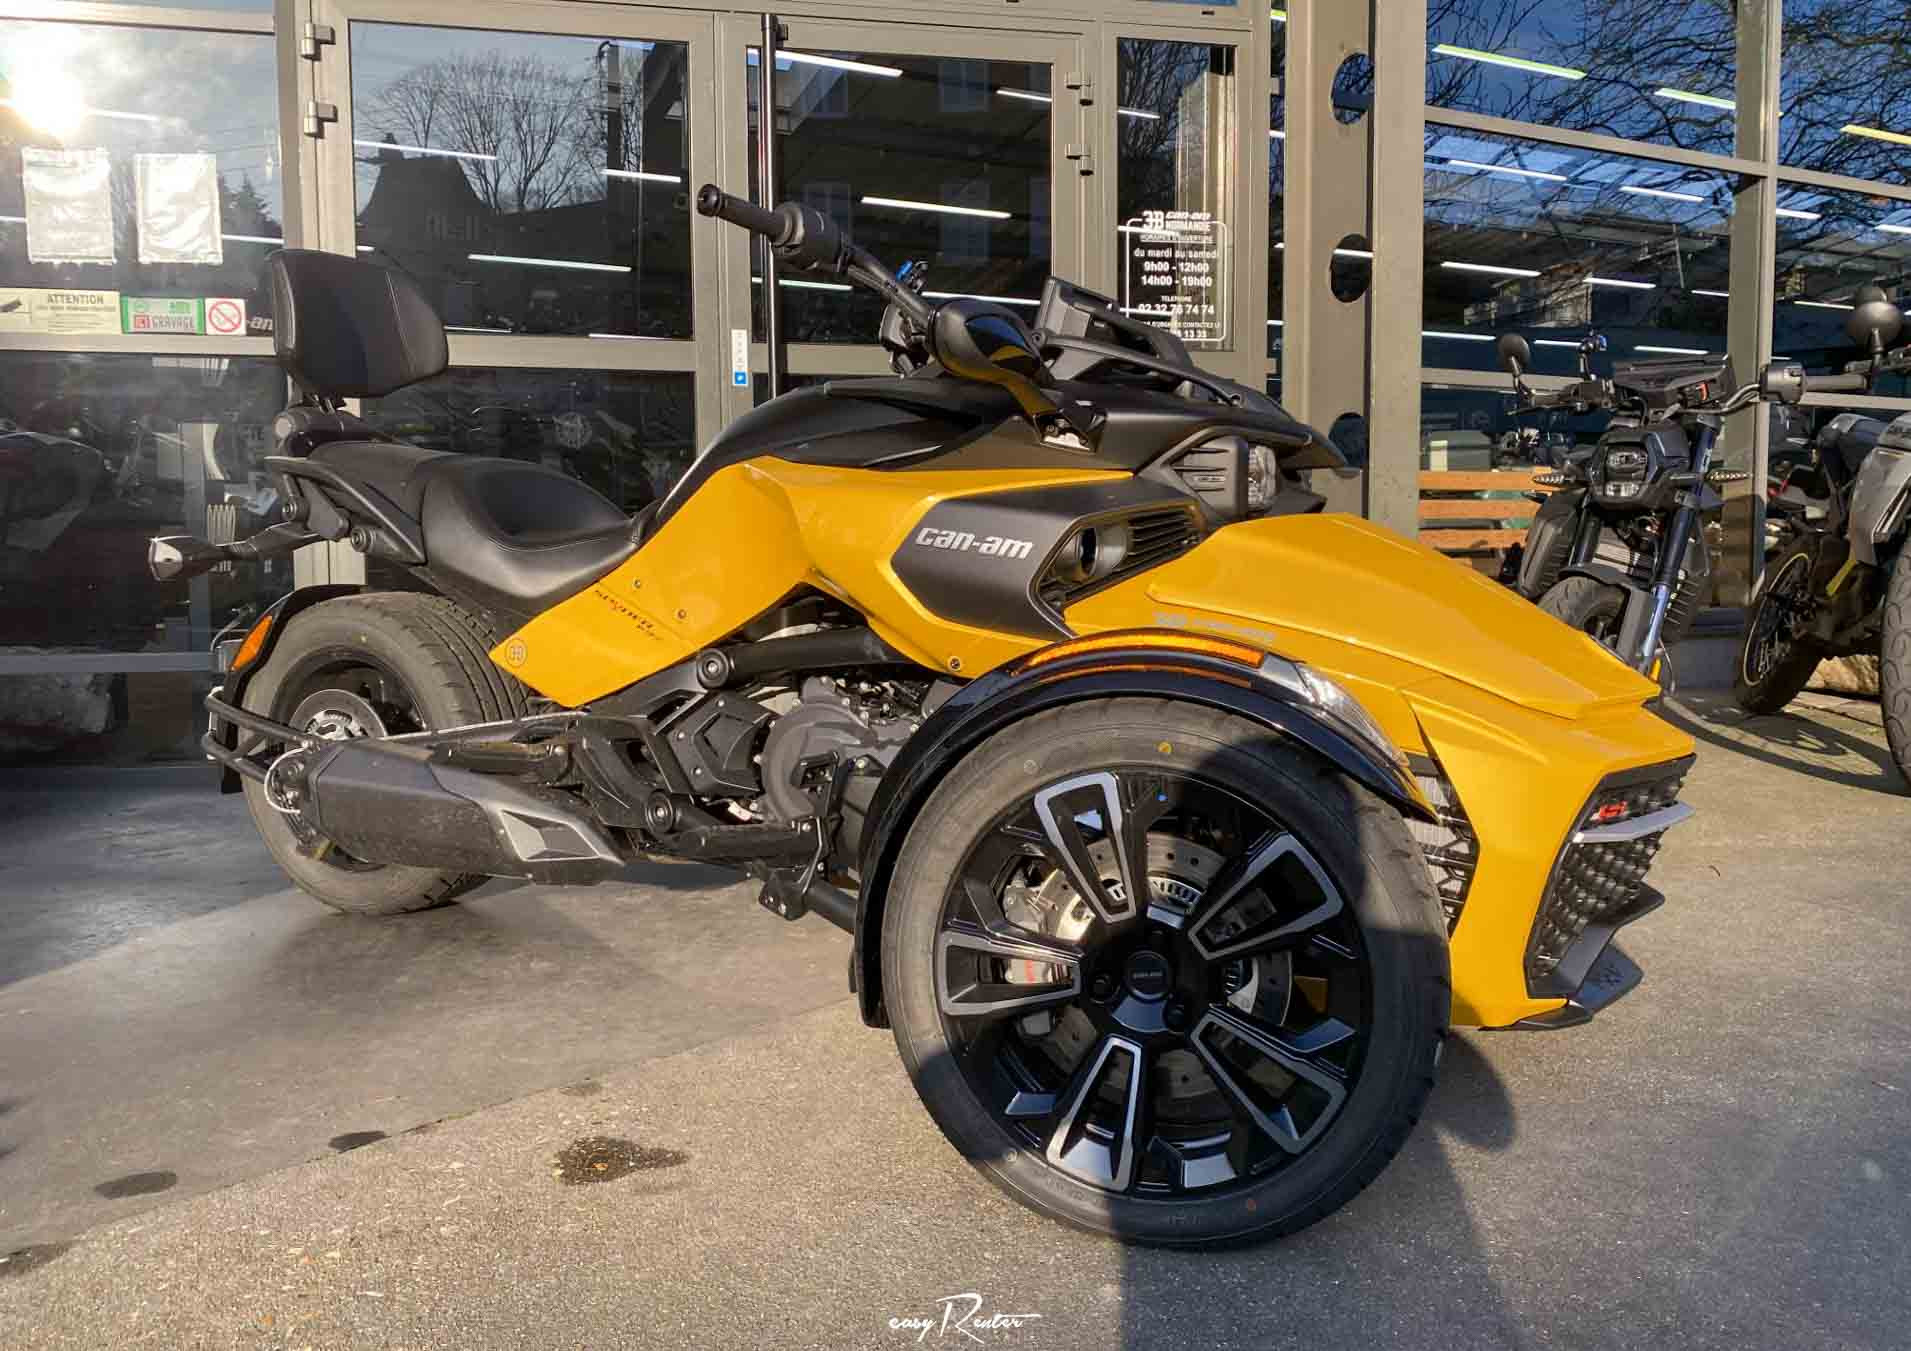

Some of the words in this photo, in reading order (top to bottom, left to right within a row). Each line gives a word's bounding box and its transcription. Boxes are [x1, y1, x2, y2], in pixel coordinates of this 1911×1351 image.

[1134, 248, 1145, 257] du
[1148, 248, 1172, 257] mardi
[1188, 248, 1219, 258] samedi
[1144, 262, 1170, 272] 9h00
[1179, 262, 1209, 272] 12h00
[1141, 276, 1173, 286] 14h00
[1182, 277, 1213, 287] 19h00
[47, 294, 104, 304] ATTENTION
[1186, 304, 1199, 314] 74
[1200, 304, 1215, 314] 74
[915, 527, 1033, 559] can-am
